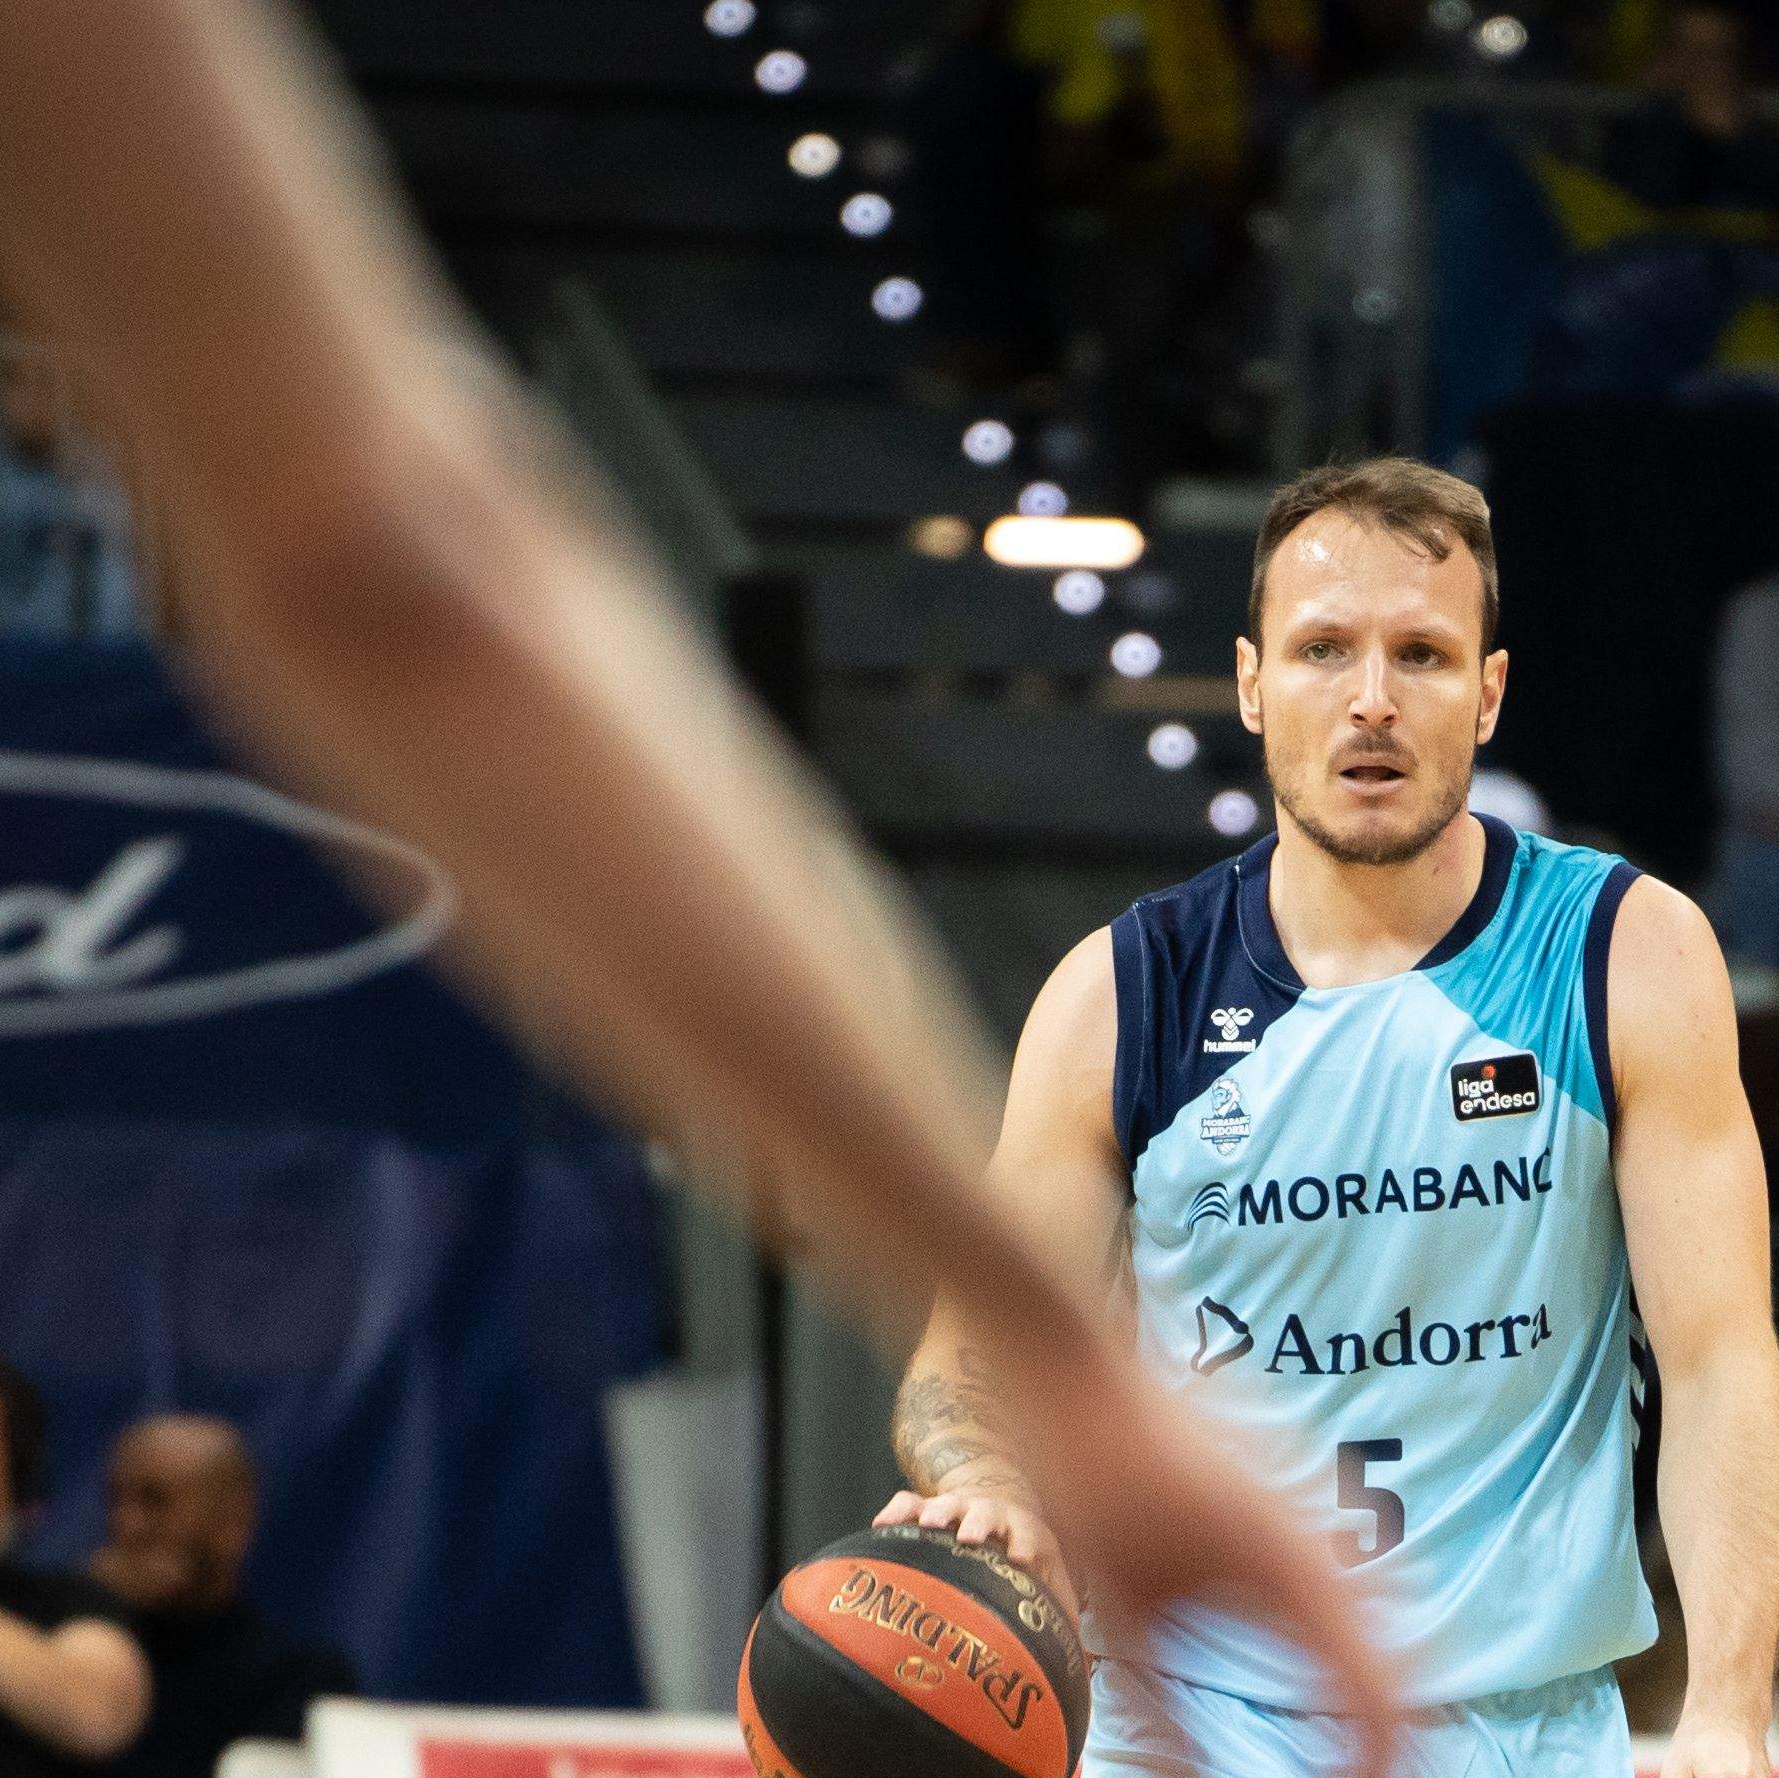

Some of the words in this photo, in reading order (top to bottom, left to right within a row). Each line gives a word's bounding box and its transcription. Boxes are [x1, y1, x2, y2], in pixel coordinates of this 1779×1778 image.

[1457, 1079, 1494, 1098] liga
[1460, 1092, 1536, 1114] endesa
[1264, 1302, 1554, 1377] Andorra
[1336, 1437, 1406, 1570] 5
[828, 1566, 1044, 1732] SPALDING
